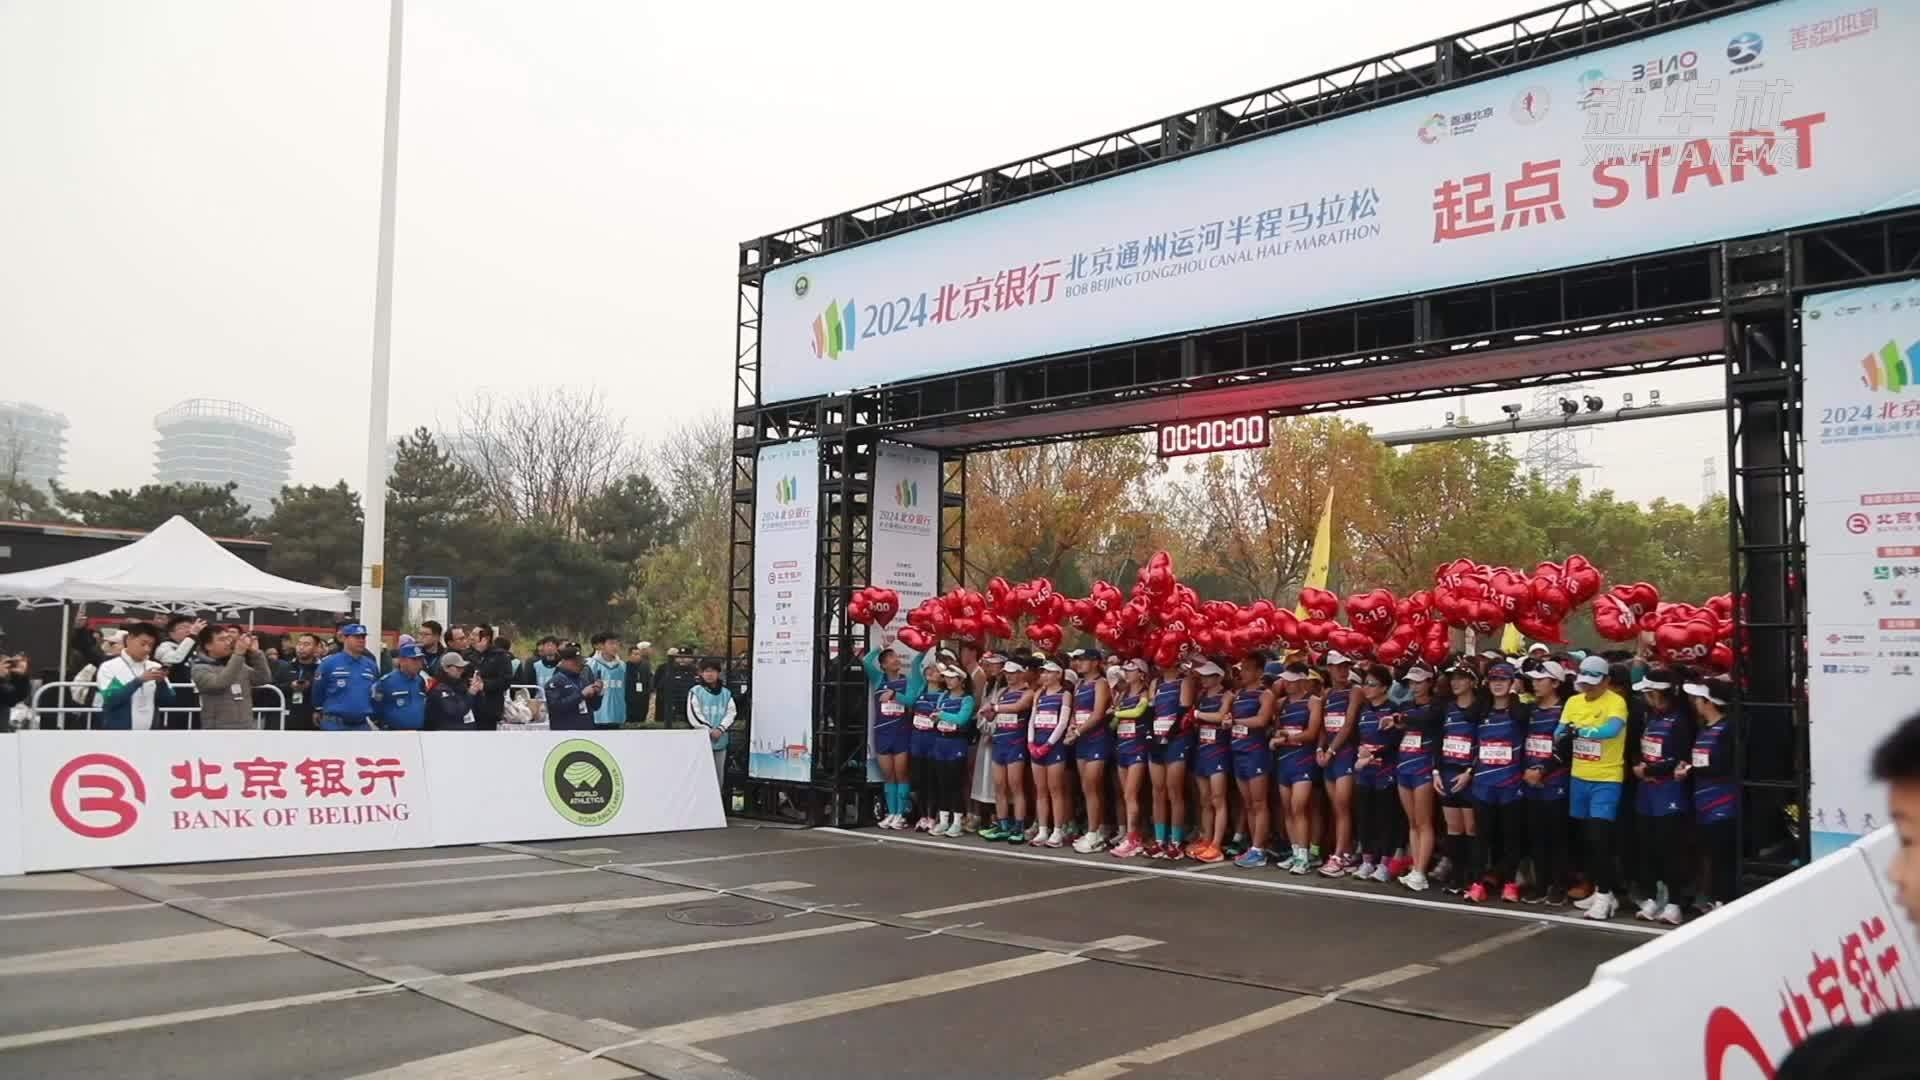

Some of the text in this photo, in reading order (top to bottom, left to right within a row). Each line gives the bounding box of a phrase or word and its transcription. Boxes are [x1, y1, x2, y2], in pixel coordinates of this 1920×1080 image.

[1433, 112, 1826, 244] 起点 START
[1065, 188, 1380, 280] 北京通州运河半程马拉松
[1065, 224, 1382, 298] BOB BEIJING TONGZHOU CANAL HALF MARATHON
[1162, 416, 1264, 452] 00:00:00
[1355, 606, 1388, 625] 2:15
[1490, 589, 1517, 610] 2:15
[170, 756, 406, 800] 北京银行
[574, 790, 599, 798] WORLD
[172, 802, 411, 830] BANK OF BEIJING
[570, 797, 605, 805] ATHLETICS
